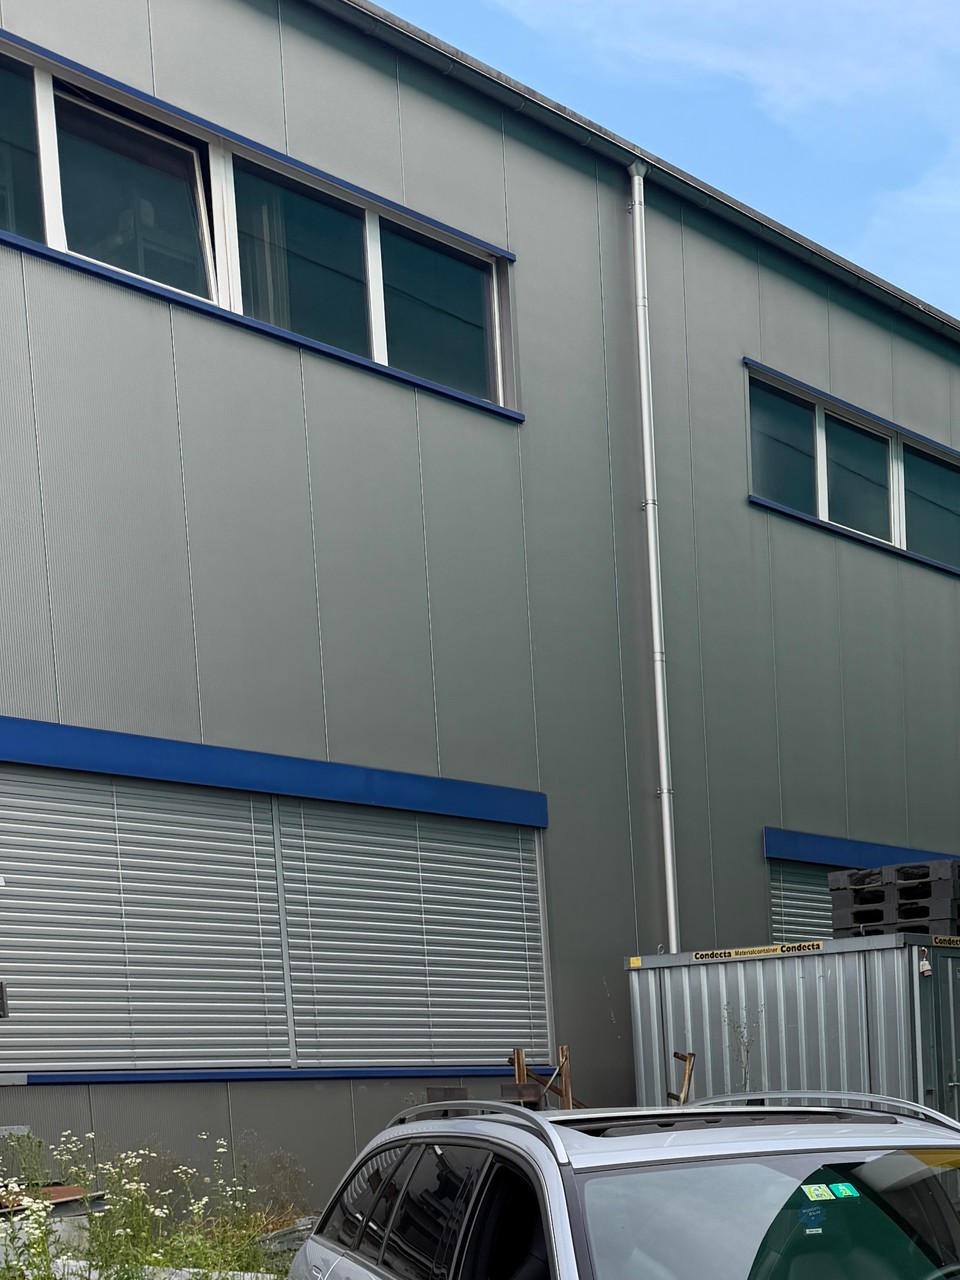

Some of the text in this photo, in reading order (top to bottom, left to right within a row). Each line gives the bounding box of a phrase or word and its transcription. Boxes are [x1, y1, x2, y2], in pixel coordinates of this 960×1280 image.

[694, 942, 821, 960] Condecta Materialcontainer Condecta
